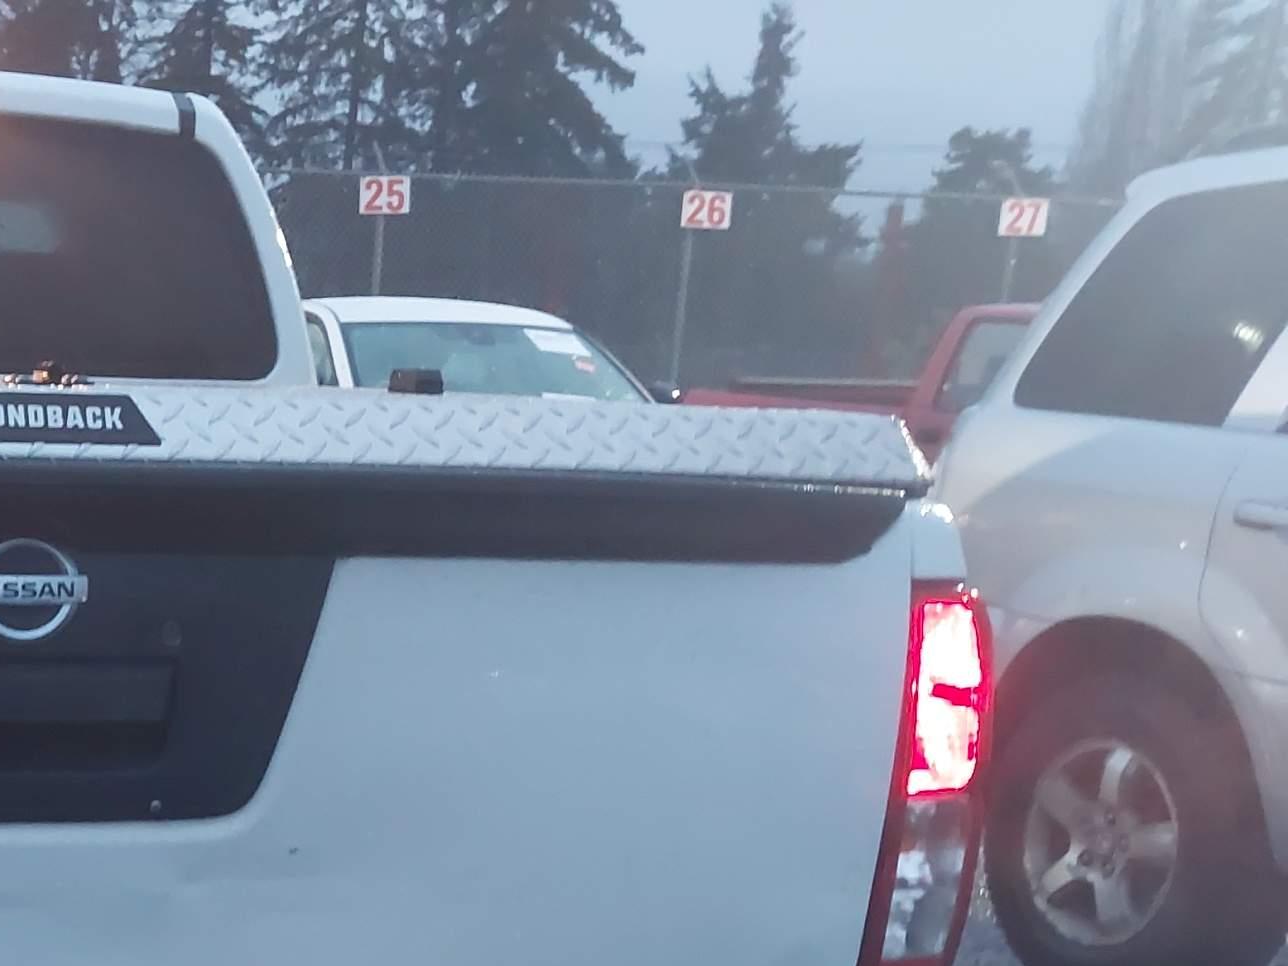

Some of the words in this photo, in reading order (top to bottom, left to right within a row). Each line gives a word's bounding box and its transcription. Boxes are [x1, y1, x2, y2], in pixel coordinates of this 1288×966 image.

[364, 178, 405, 212] 25
[686, 193, 726, 225] 26
[1005, 201, 1041, 234] 27
